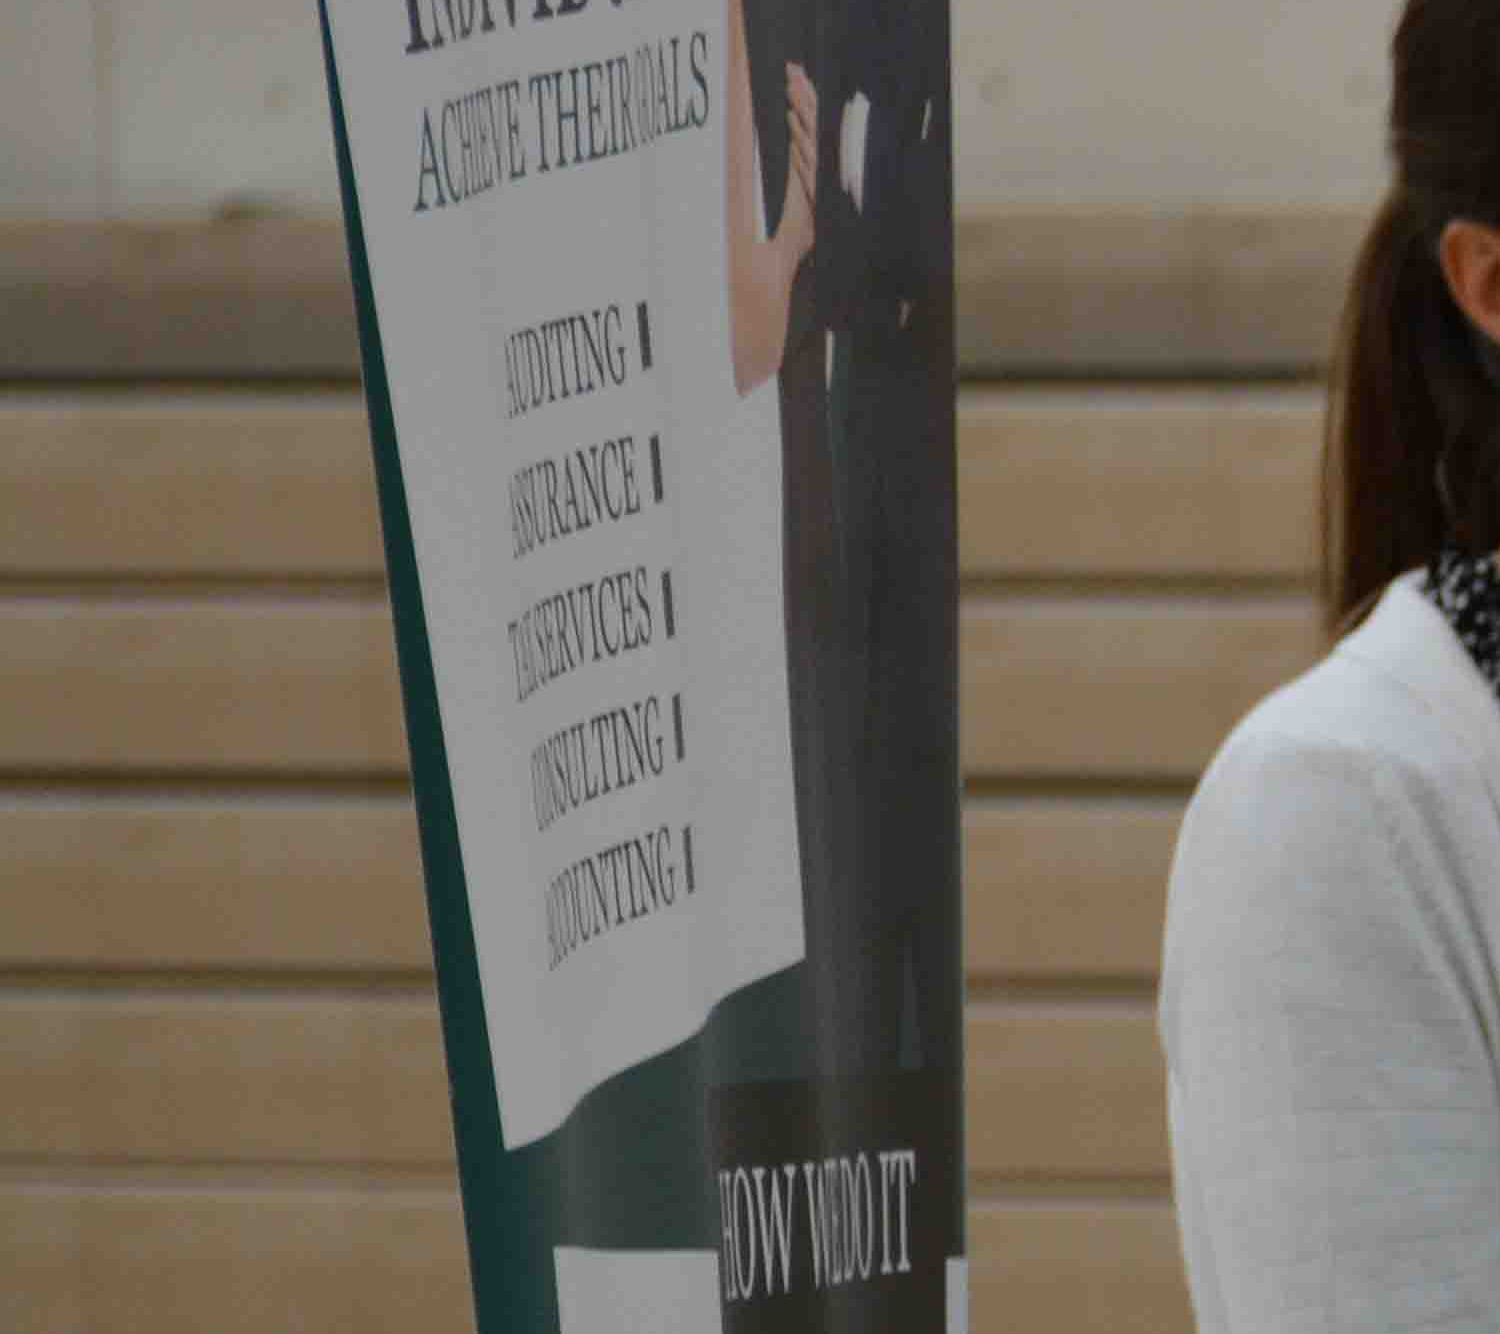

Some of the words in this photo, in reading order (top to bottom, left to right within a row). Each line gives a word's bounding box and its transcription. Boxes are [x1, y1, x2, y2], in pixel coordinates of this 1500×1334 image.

[528, 53, 636, 174] THEIR
[504, 301, 626, 419] AUDITING
[719, 1164, 797, 1302] HOW
[879, 1150, 918, 1275] IT
